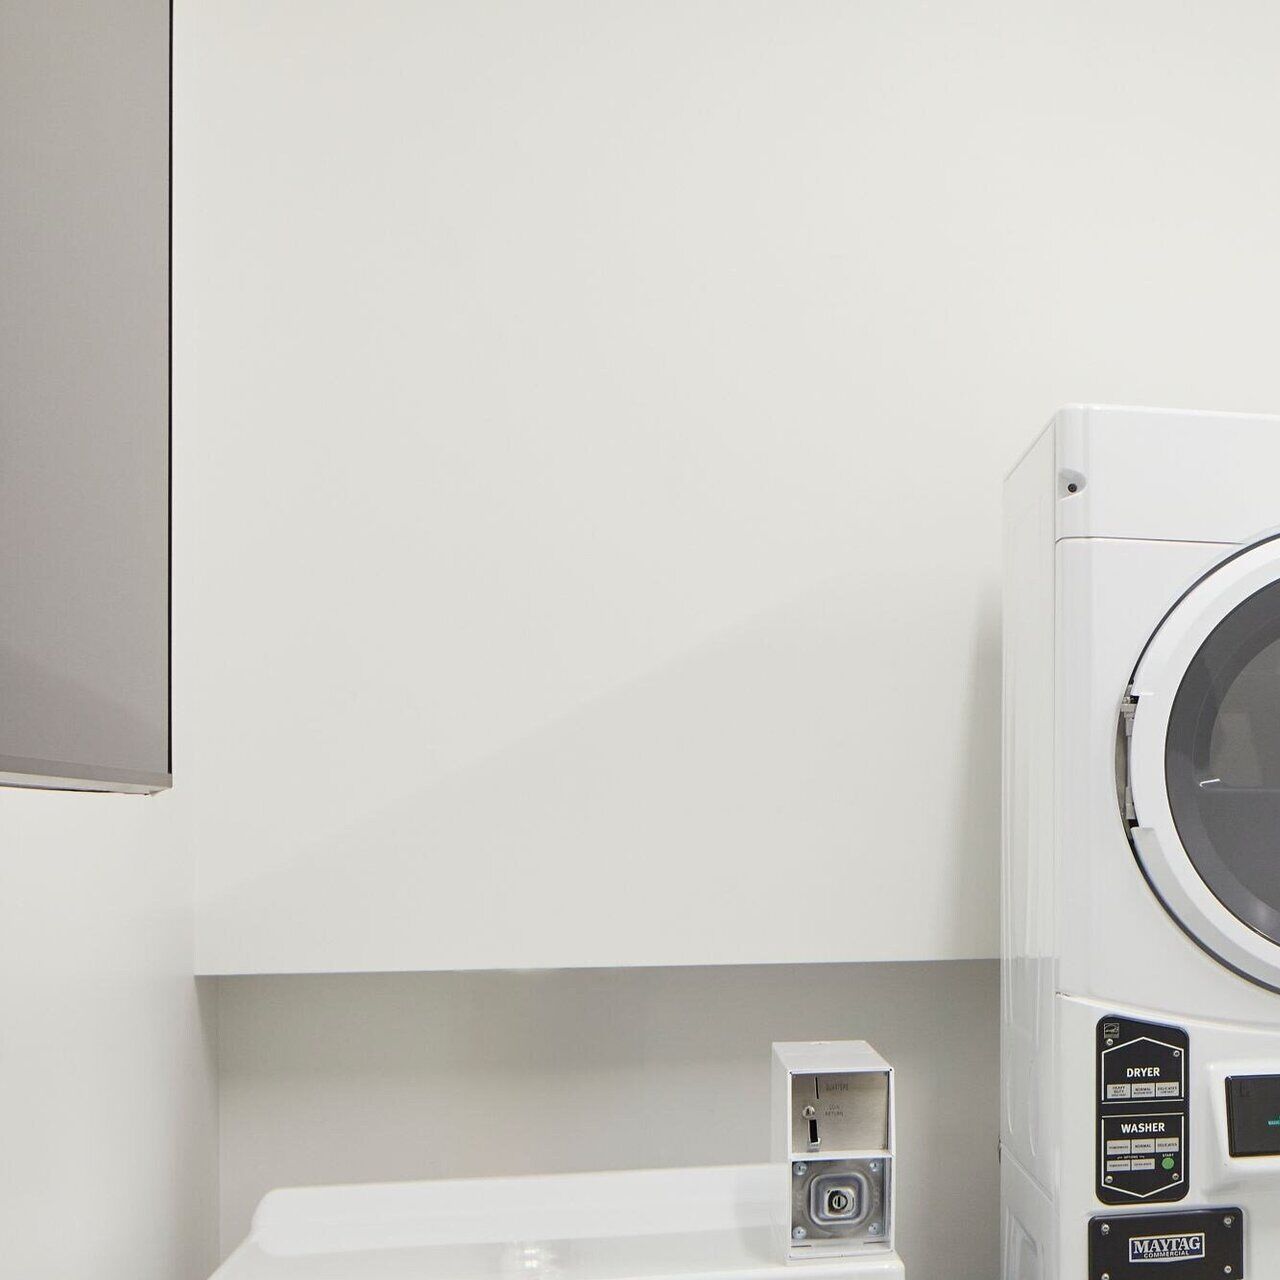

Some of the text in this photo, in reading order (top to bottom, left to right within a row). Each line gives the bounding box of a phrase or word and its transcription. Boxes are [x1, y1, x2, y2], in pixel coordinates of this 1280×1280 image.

[1126, 1067, 1160, 1078] DRYER
[1120, 1122, 1166, 1134] WASHER
[1133, 1236, 1201, 1254] MAYTAG
[1143, 1250, 1190, 1259] COMMERCIAL
